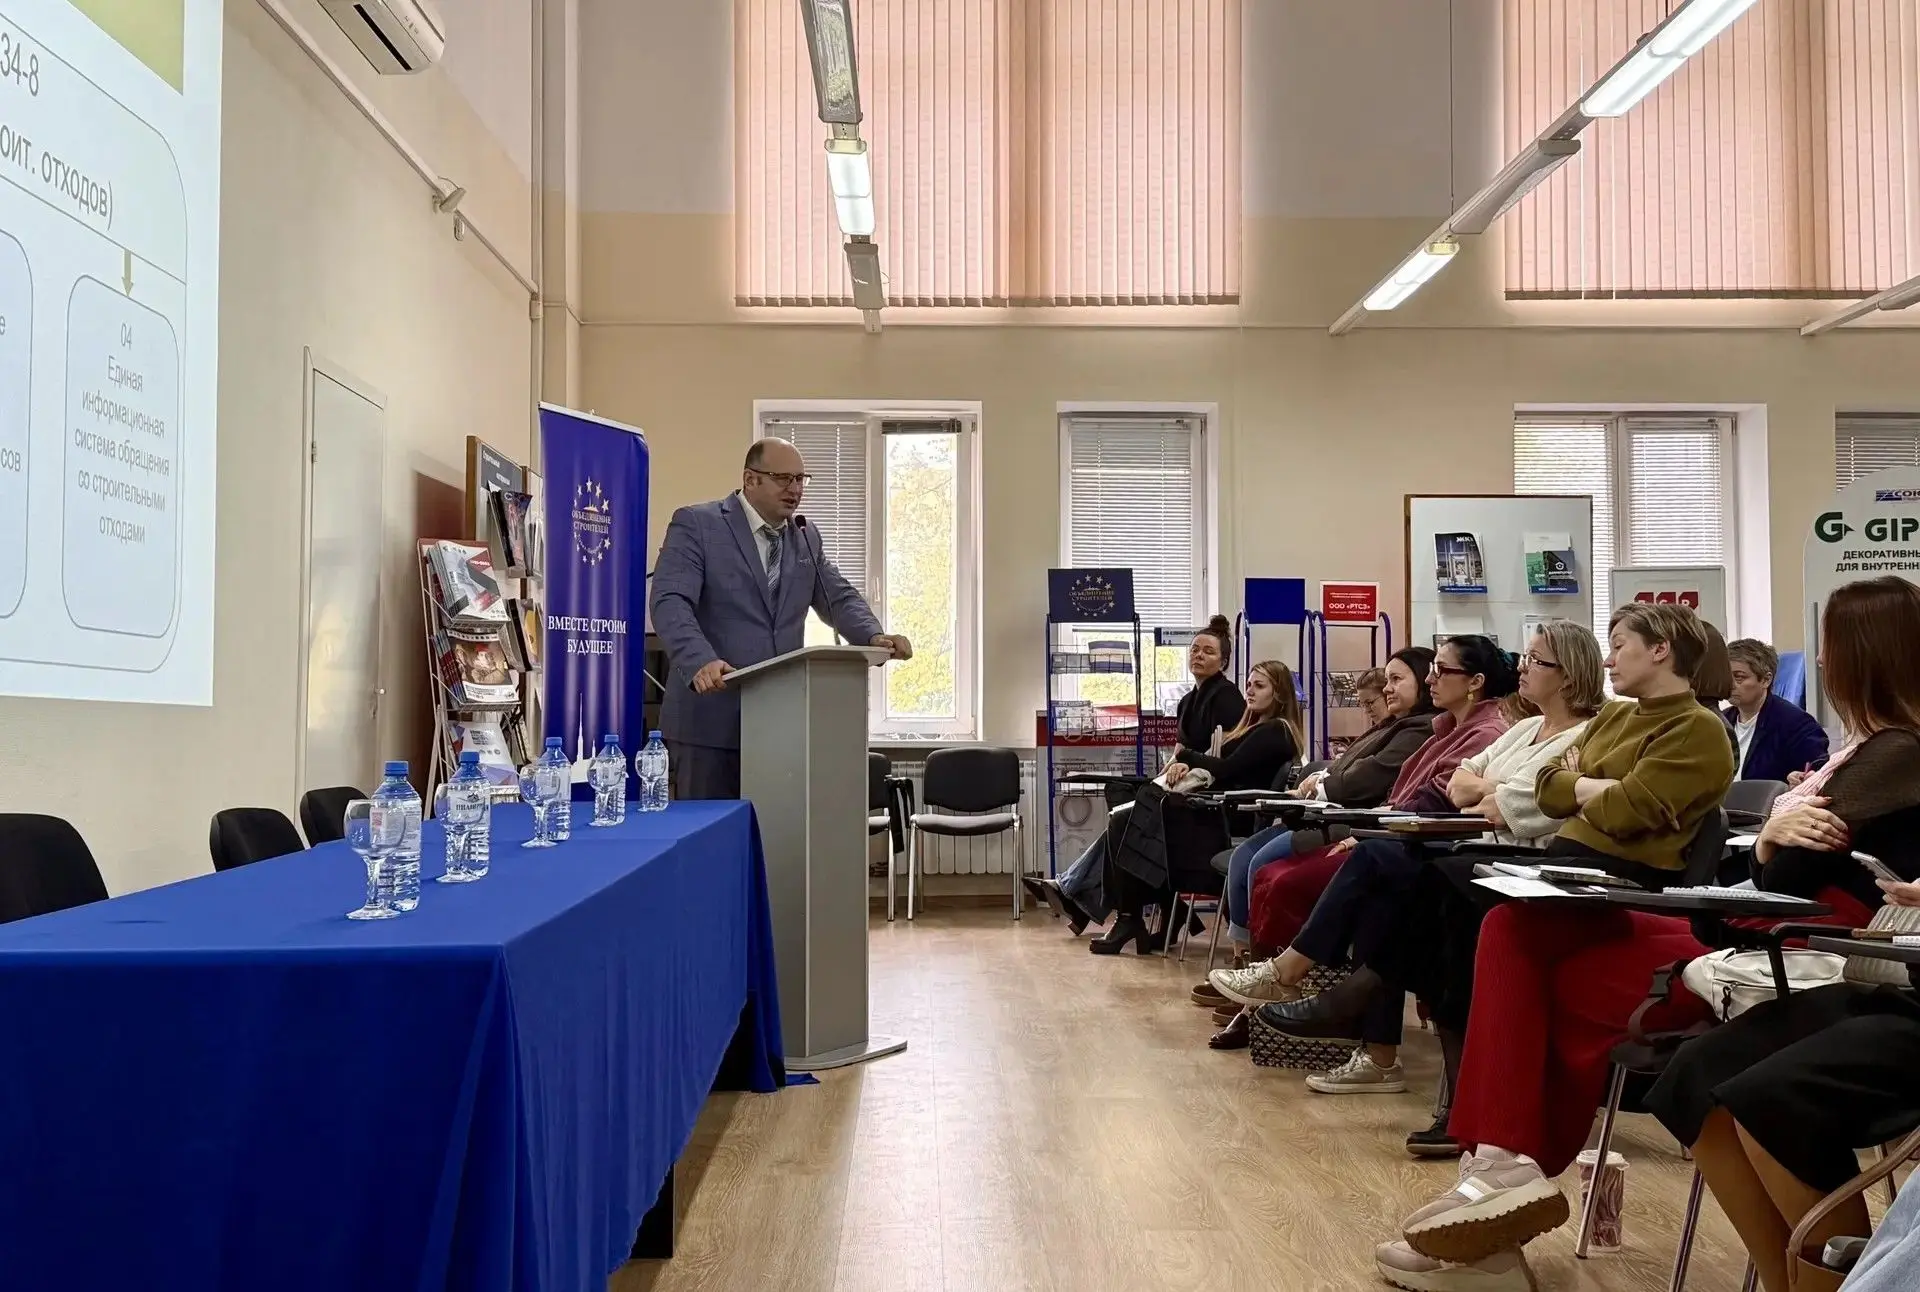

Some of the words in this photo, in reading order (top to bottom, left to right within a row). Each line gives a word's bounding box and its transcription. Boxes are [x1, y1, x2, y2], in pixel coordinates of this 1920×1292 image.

[41, 151, 113, 231] ОТХОДОВ)
[120, 322, 133, 350] 04
[108, 355, 143, 393] Единая
[82, 389, 165, 439] информационная
[74, 428, 116, 459] система
[118, 440, 170, 477] обращения
[78, 470, 90, 491] со
[92, 474, 166, 512] строительными
[99, 516, 146, 544] отходами
[1836, 563, 1859, 572] ДЛЯ
[547, 615, 589, 632] ВМЕСТЕ
[590, 618, 627, 634] СТРОИМ
[567, 638, 614, 656] БУДУЩЕЕ
